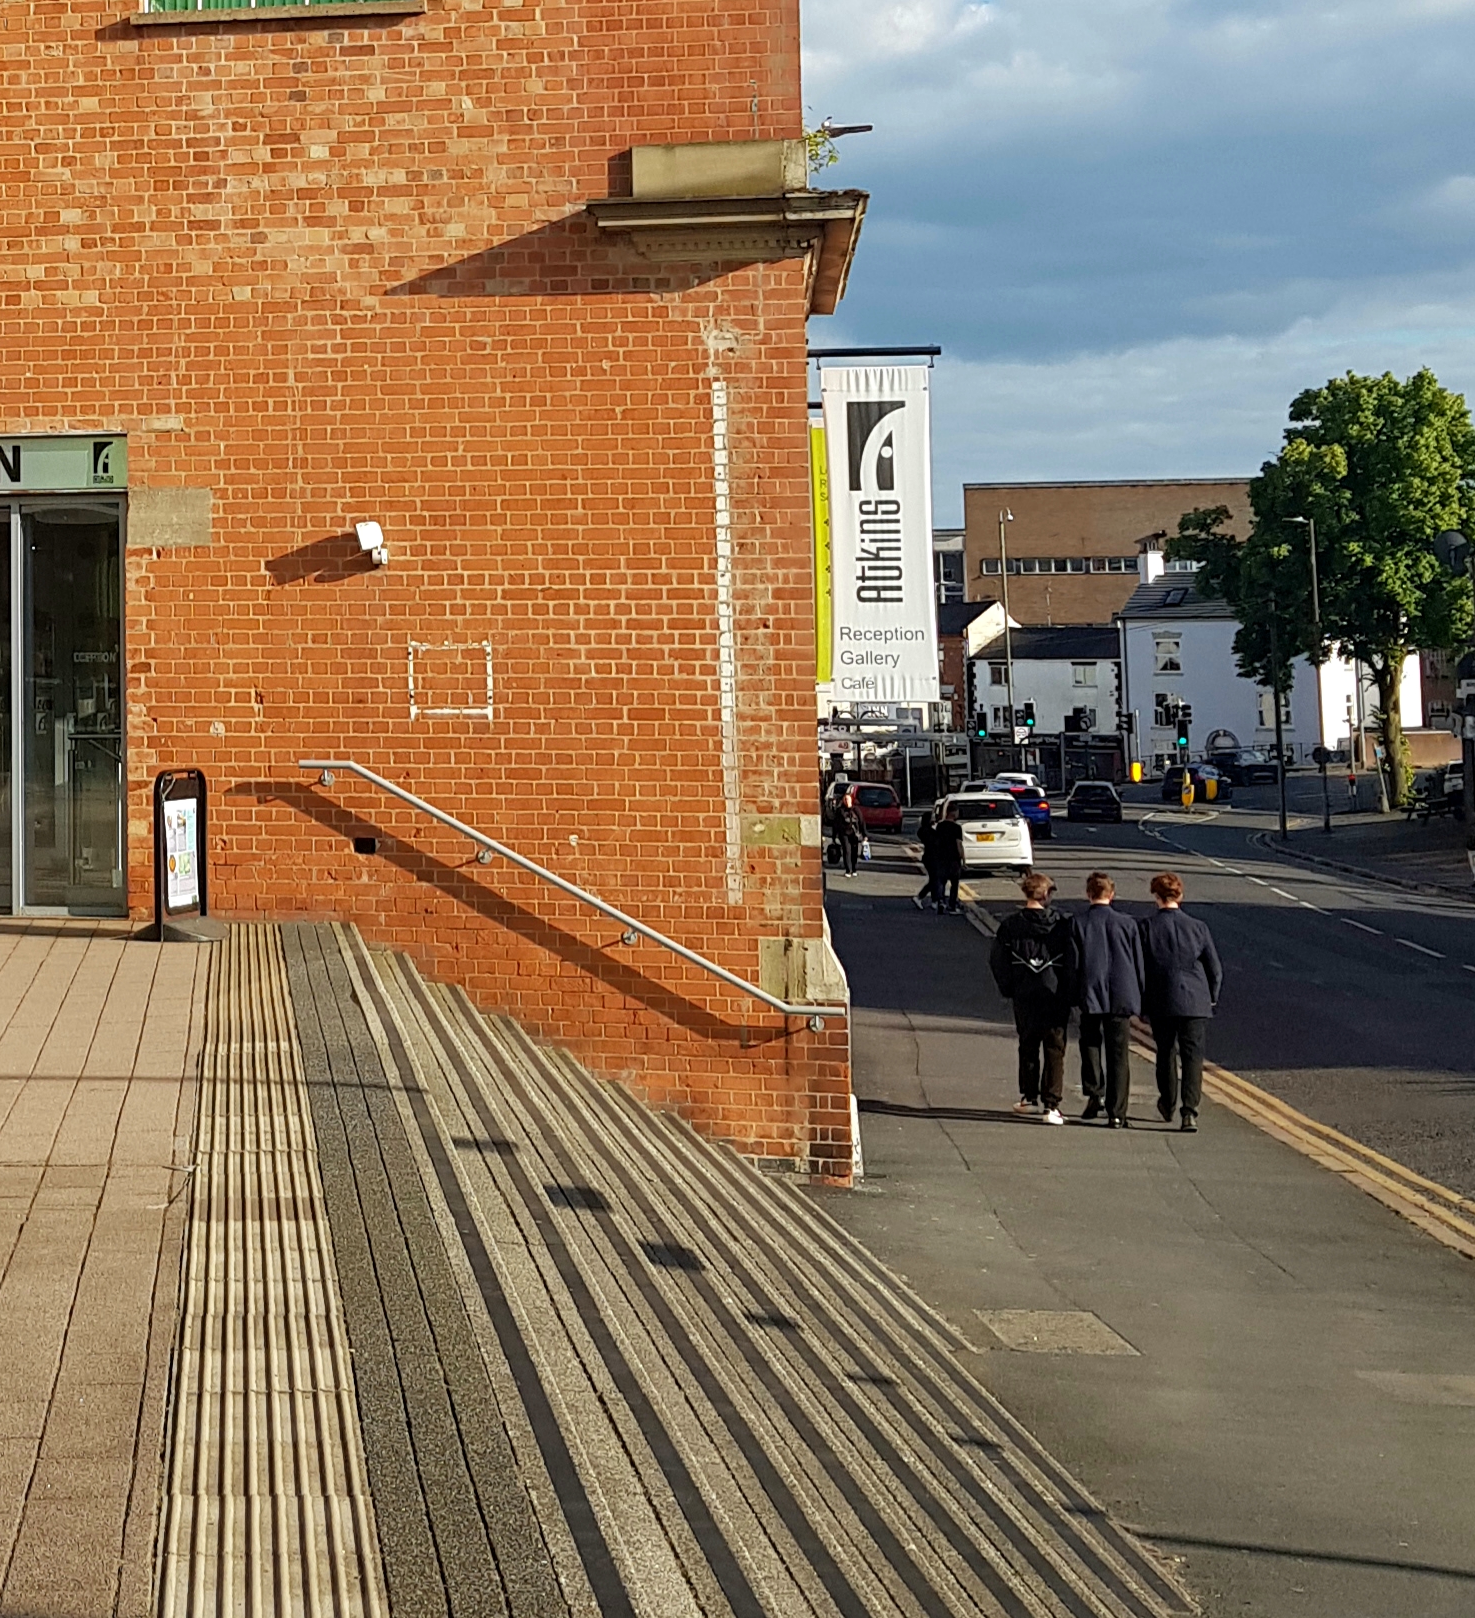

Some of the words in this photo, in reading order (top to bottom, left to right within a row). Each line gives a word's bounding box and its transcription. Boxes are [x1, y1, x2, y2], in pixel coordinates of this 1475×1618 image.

[855, 499, 903, 603] Atkins
[839, 626, 925, 644] Reception
[840, 650, 901, 669] Gallery
[841, 676, 875, 690] Café
